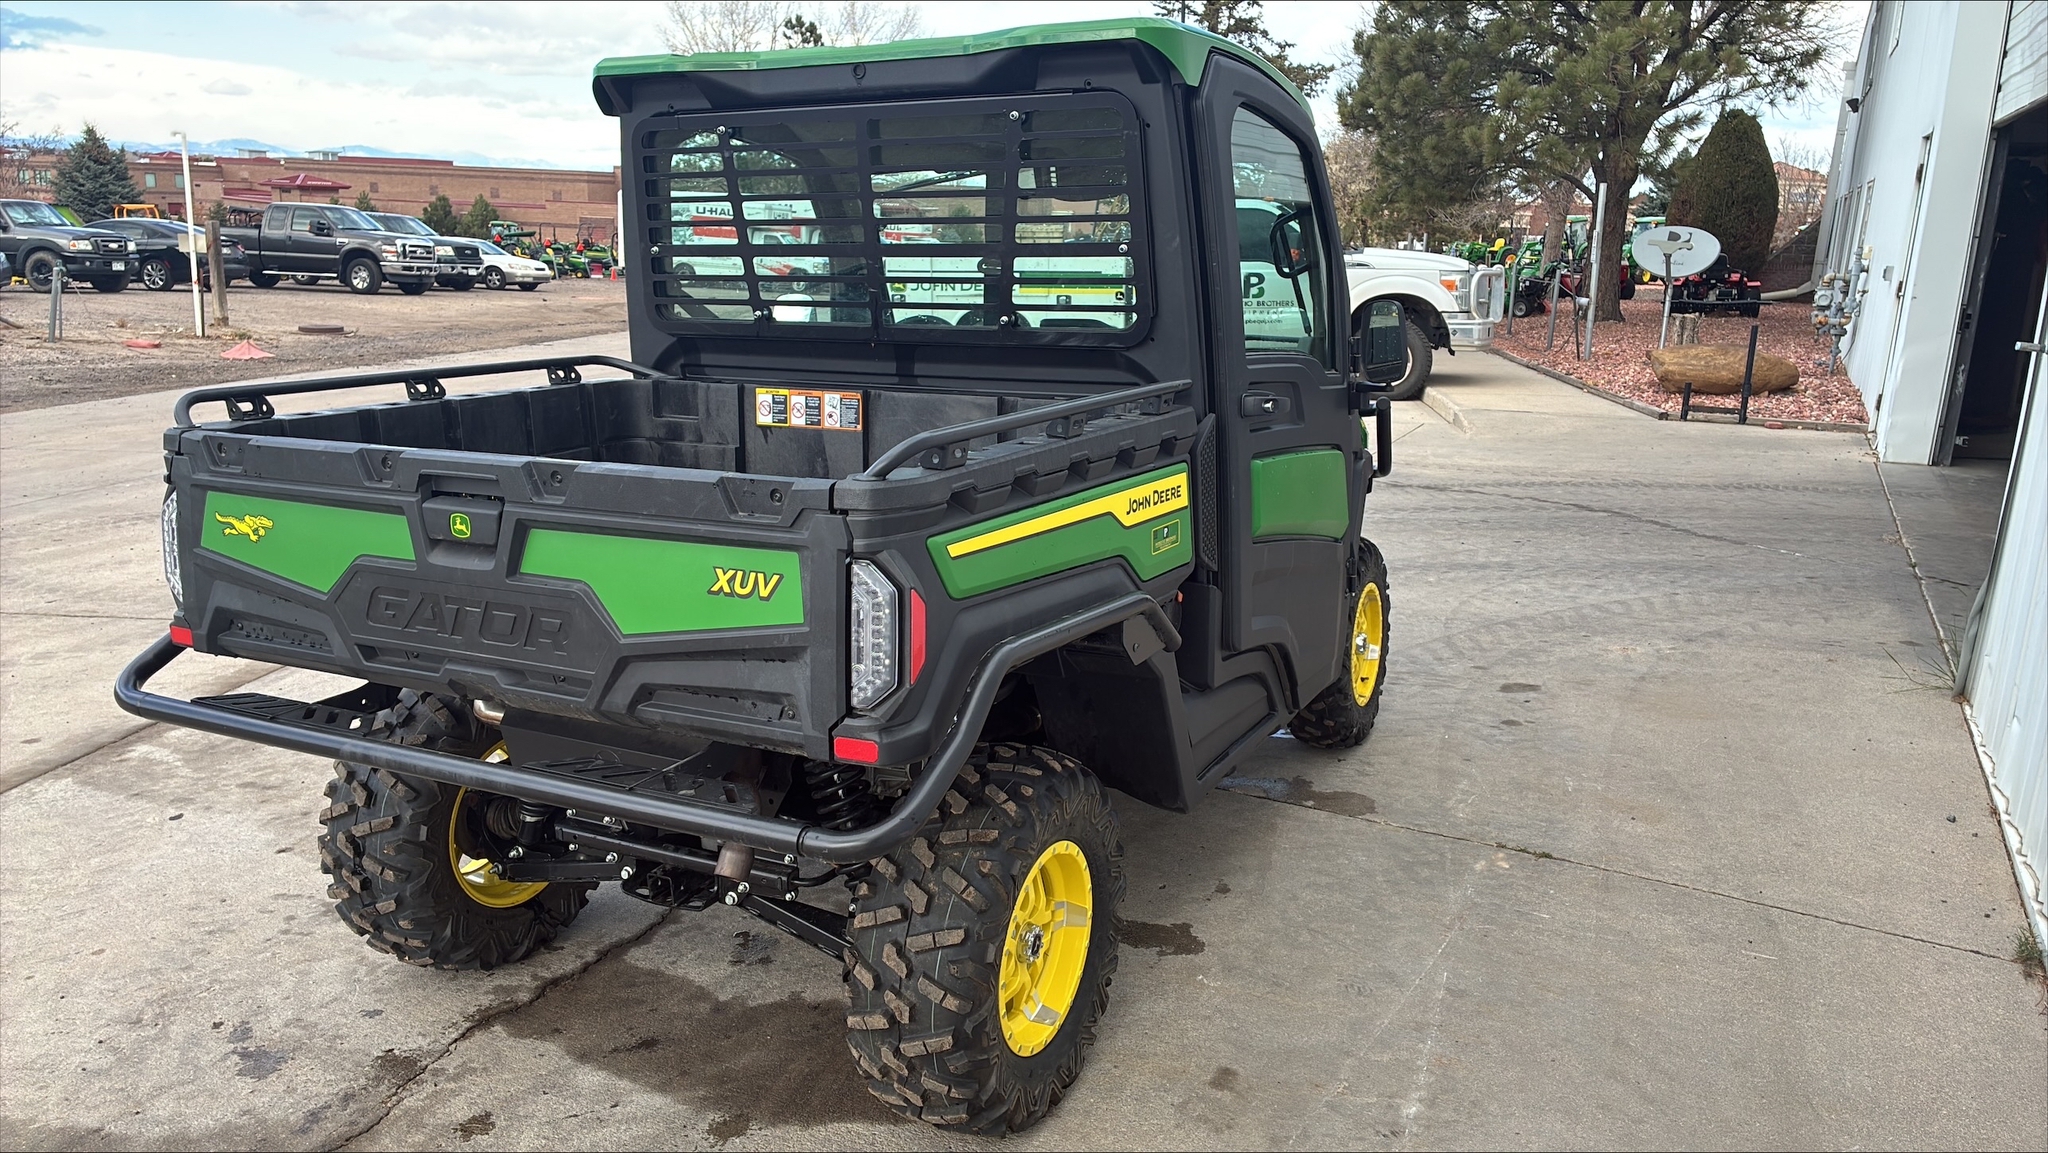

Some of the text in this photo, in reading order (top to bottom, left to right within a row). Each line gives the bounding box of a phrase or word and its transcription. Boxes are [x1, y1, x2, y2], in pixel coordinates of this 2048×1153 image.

[696, 206, 734, 217] U-HAU
[1126, 485, 1182, 515] JOHN DEERE
[707, 566, 784, 602] XUV
[366, 585, 573, 655] GATOR
